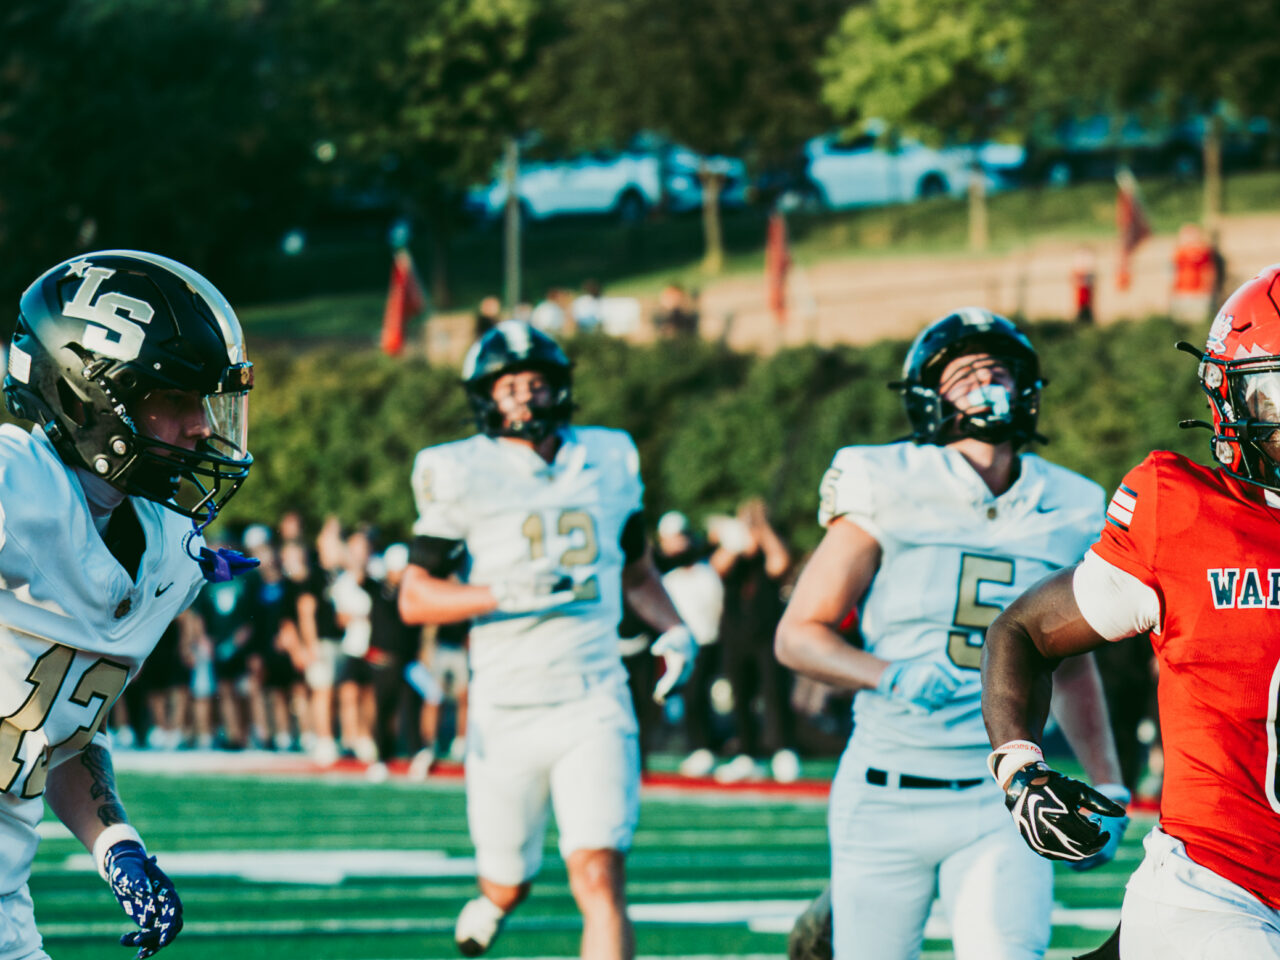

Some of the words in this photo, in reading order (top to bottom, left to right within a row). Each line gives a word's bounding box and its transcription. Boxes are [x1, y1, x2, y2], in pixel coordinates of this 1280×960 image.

[62, 267, 155, 361] LS
[520, 508, 600, 602] 12
[947, 552, 1015, 670] 5
